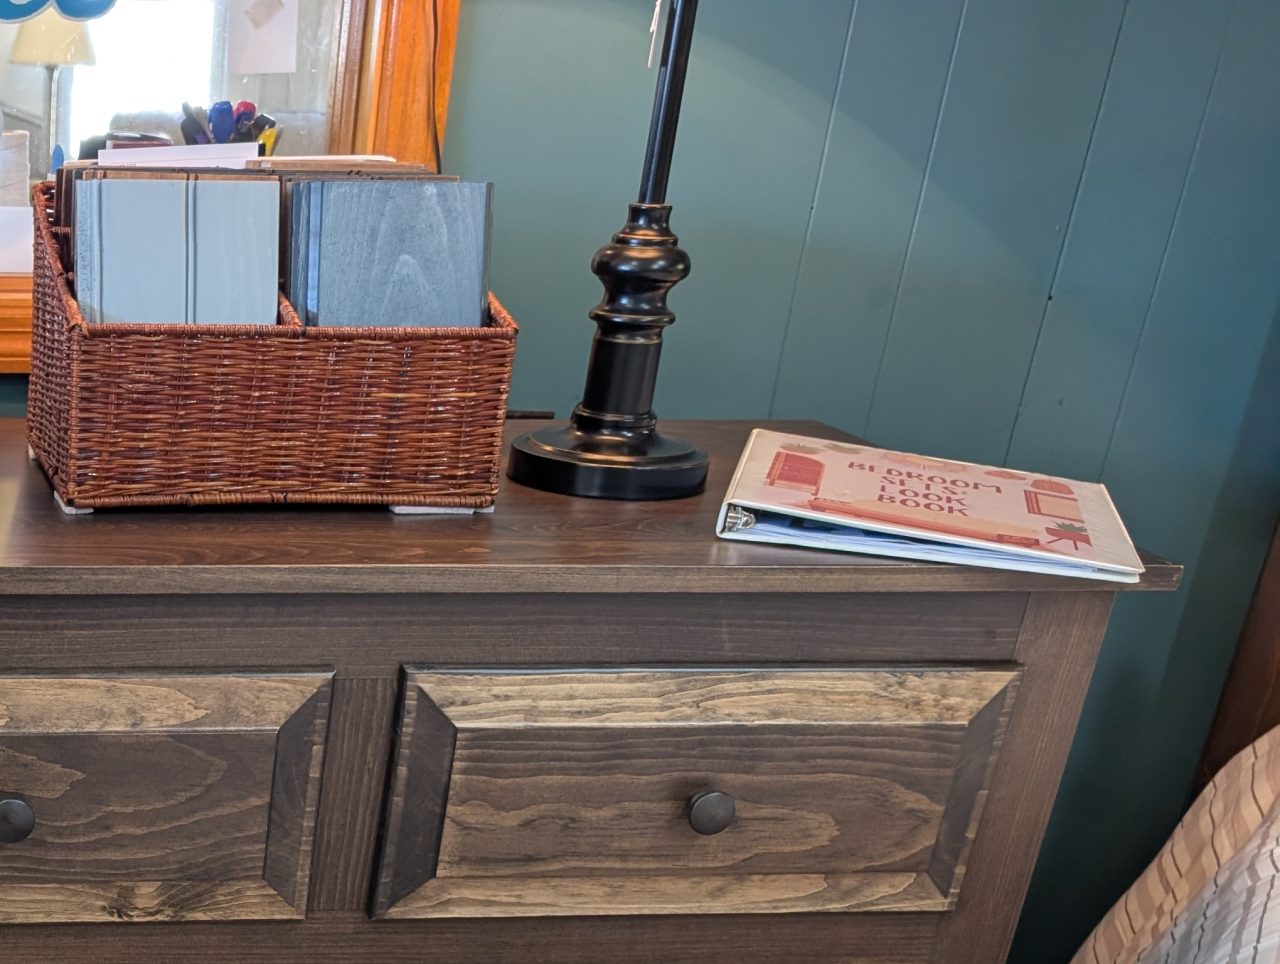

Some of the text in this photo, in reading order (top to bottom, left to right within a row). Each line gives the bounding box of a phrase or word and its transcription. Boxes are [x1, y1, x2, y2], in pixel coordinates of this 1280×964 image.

[848, 461, 1002, 494] BEDROOM
[877, 494, 969, 517] BOOK
[880, 485, 968, 506] LOOK
